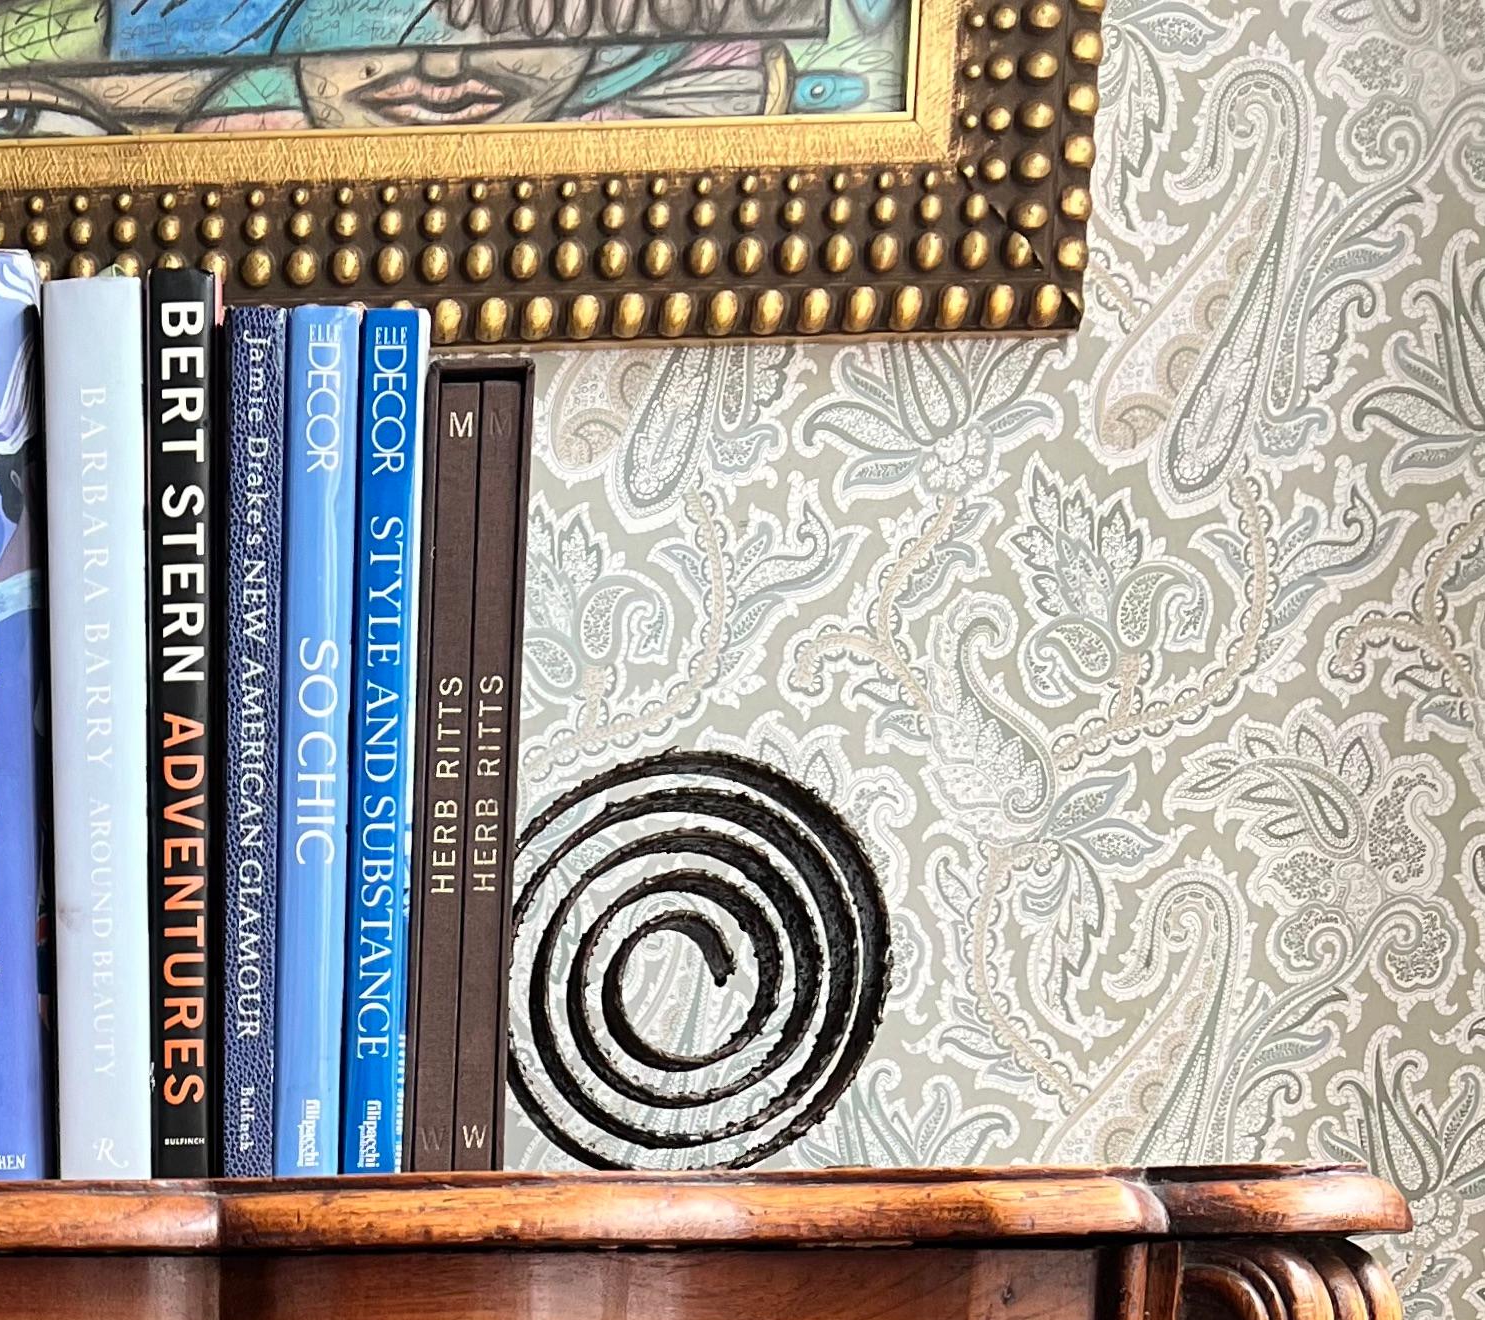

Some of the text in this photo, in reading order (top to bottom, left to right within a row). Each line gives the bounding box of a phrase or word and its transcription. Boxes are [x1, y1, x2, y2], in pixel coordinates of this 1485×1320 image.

[309, 324, 341, 344] ELLE
[375, 326, 408, 345] ELLE
[305, 343, 341, 473] DECOR
[371, 345, 407, 476] DECOR
[449, 411, 474, 439] M
[487, 407, 513, 438] M
[79, 385, 117, 1079] BARBARA BARRY AROUND BEAUTY
[161, 301, 206, 1106] BERT STERN ADVENTURES
[237, 329, 272, 1040] Jamie Drake's NEW AMERICAN GLAMOUR
[295, 637, 340, 866] SO CHIC
[356, 516, 404, 1060] STYLE AND SUBSTANCE
[431, 676, 464, 895] HERB RITTS
[472, 675, 504, 892] HERB RITTS
[93, 1138, 129, 1168] R
[164, 1137, 206, 1146] BULFINCH
[239, 1086, 256, 1152] Bulfinch
[363, 1100, 382, 1168] filipacchi
[462, 1124, 488, 1150] W
